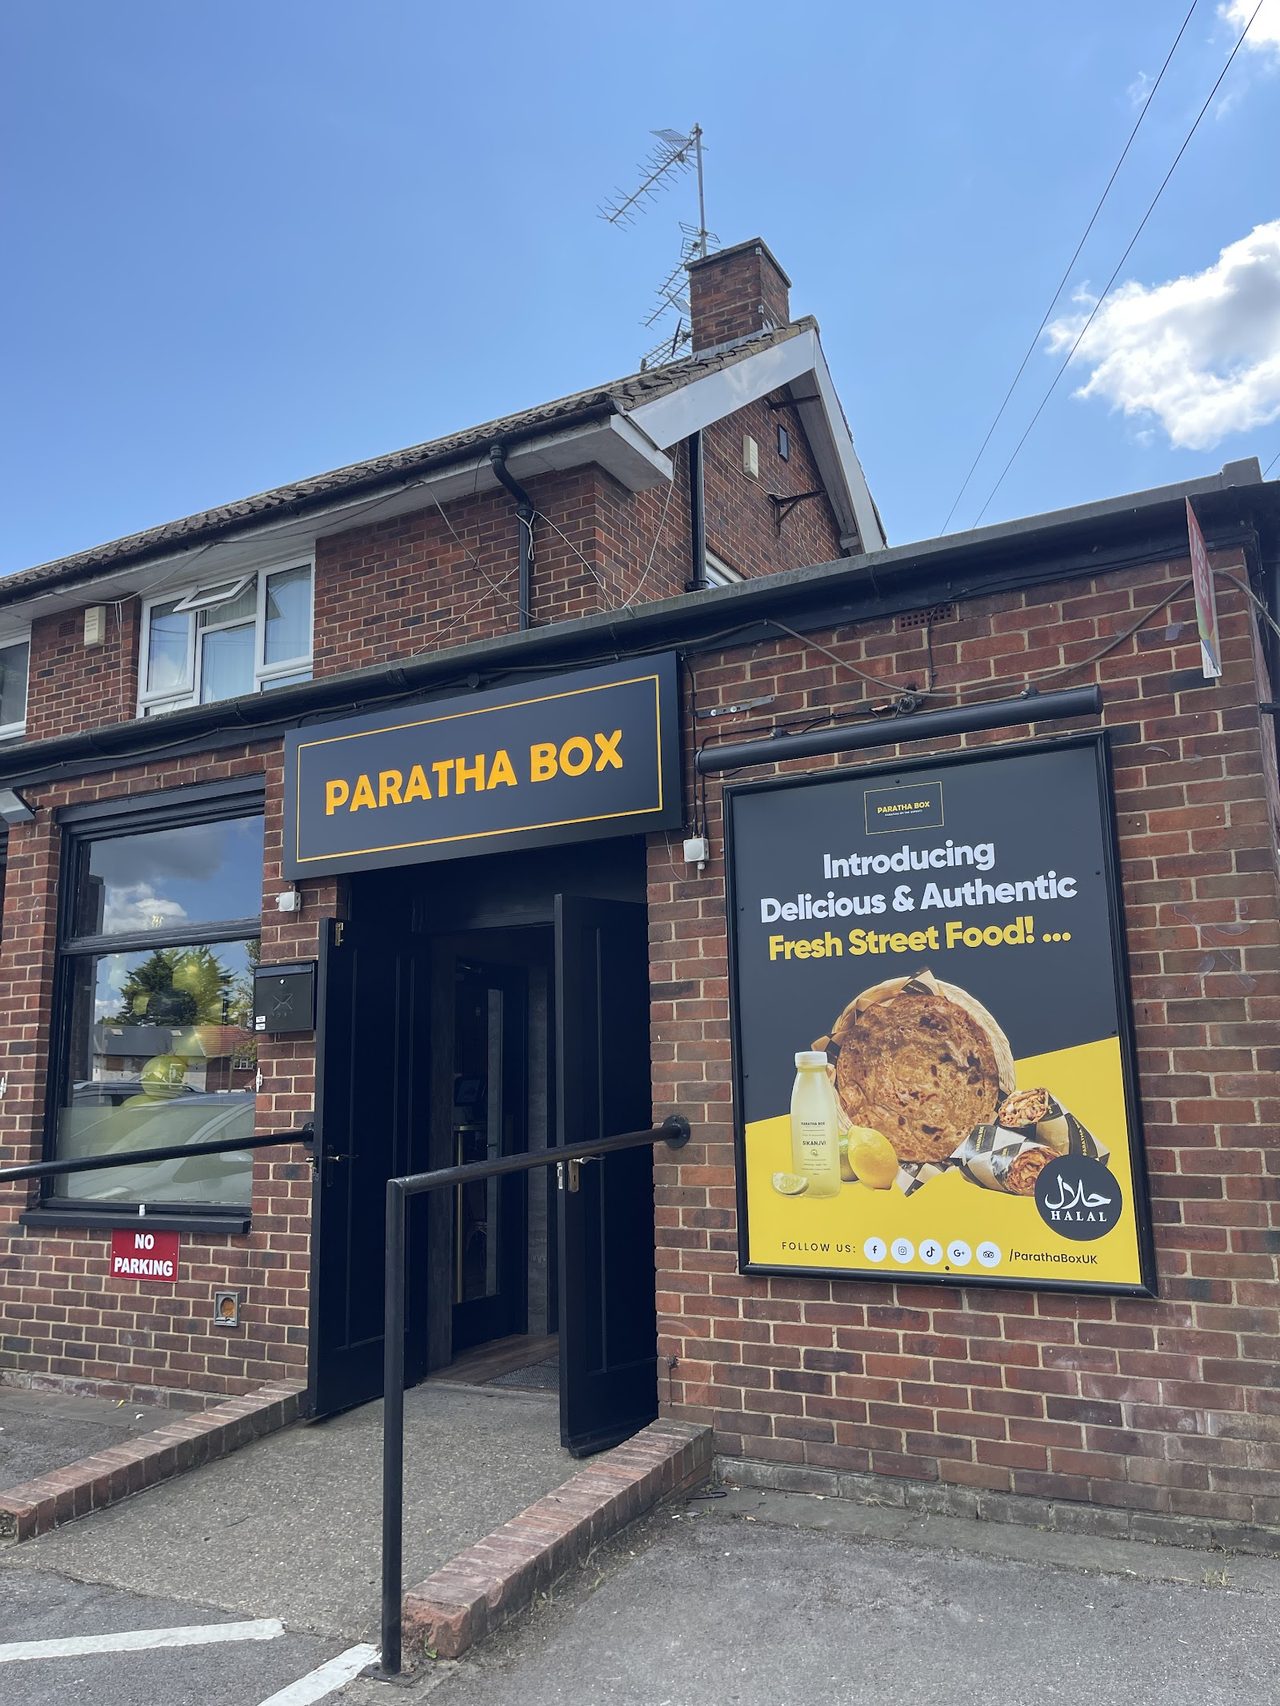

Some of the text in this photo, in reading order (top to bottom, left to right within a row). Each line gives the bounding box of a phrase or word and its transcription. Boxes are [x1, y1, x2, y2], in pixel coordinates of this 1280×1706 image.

[325, 729, 623, 816] PARATHA BOX
[877, 803, 913, 814] PARATHA
[914, 801, 930, 809] BOX
[823, 839, 996, 879] Introducing
[760, 870, 1078, 923] Delicious & Authentic
[768, 931, 843, 961] Fresh
[848, 926, 940, 957] Street
[945, 915, 1035, 950] Food!
[1044, 1173, 1112, 1210] حلال
[1050, 1210, 1107, 1222] HALAL
[134, 1233, 155, 1250] NO
[781, 1241, 830, 1252] FOLLOW
[836, 1243, 857, 1253] US:
[1009, 1248, 1099, 1265] /ParathaBoxUK
[113, 1257, 174, 1277] PARKING
